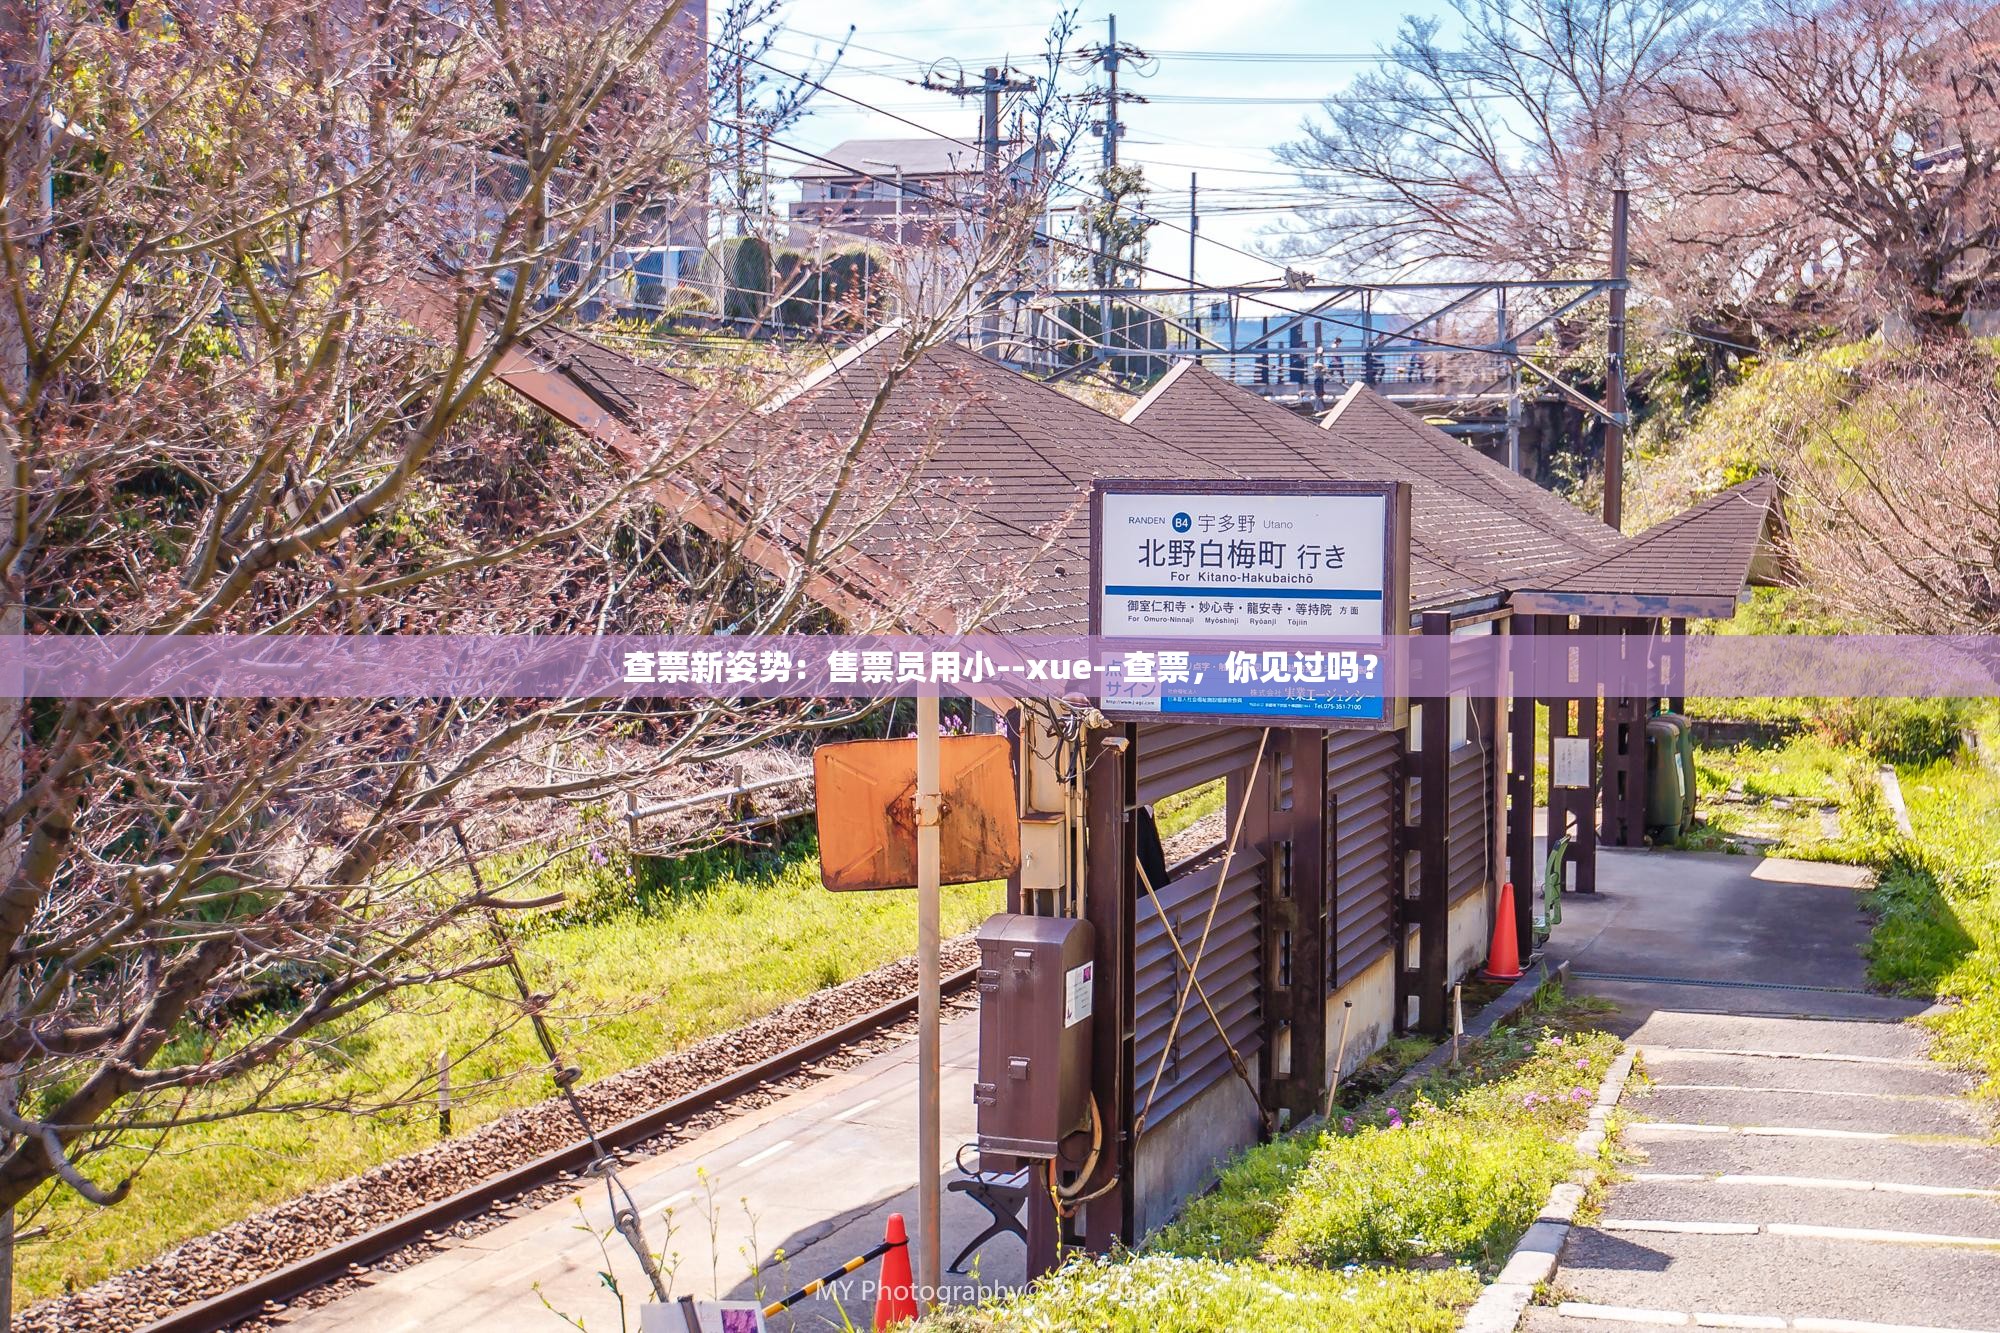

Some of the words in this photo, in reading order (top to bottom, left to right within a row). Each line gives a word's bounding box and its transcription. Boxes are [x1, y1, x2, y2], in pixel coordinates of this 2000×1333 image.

[1128, 516, 1166, 525] RANDEN
[1175, 518, 1189, 528] B4
[1197, 513, 1256, 534] 宇多野
[1263, 519, 1294, 530] Utano
[1138, 538, 1287, 569] 北野白梅町
[1296, 543, 1347, 570] 行き
[1170, 571, 1191, 582] For
[1198, 571, 1314, 584] Kitano-Hakubaichō
[1127, 615, 1140, 623] For
[1339, 605, 1360, 616] 方面
[1105, 680, 1156, 698] サイン
[1249, 688, 1283, 697] 株式会社
[1284, 686, 1376, 703] 実業エージェンシー
